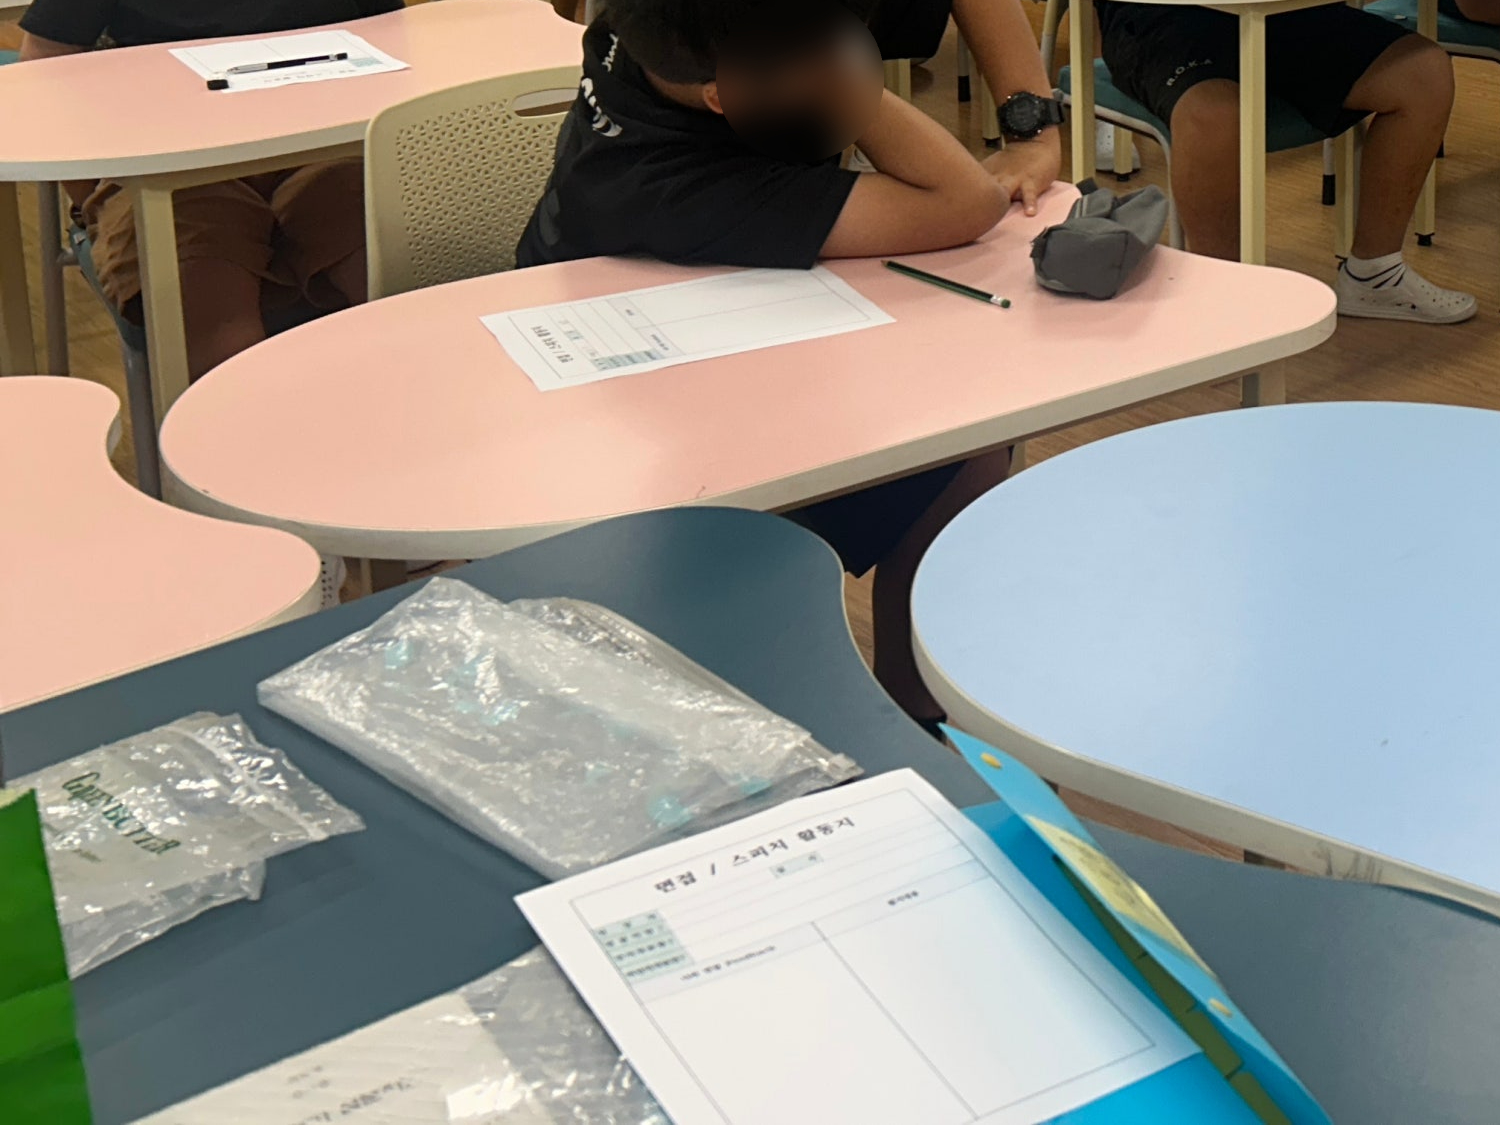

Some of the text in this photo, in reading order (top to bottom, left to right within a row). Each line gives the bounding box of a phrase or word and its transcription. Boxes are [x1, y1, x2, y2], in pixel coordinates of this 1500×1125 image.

[654, 871, 697, 893] 면접
[732, 839, 789, 866] 스피치
[797, 817, 855, 842] 활동지
